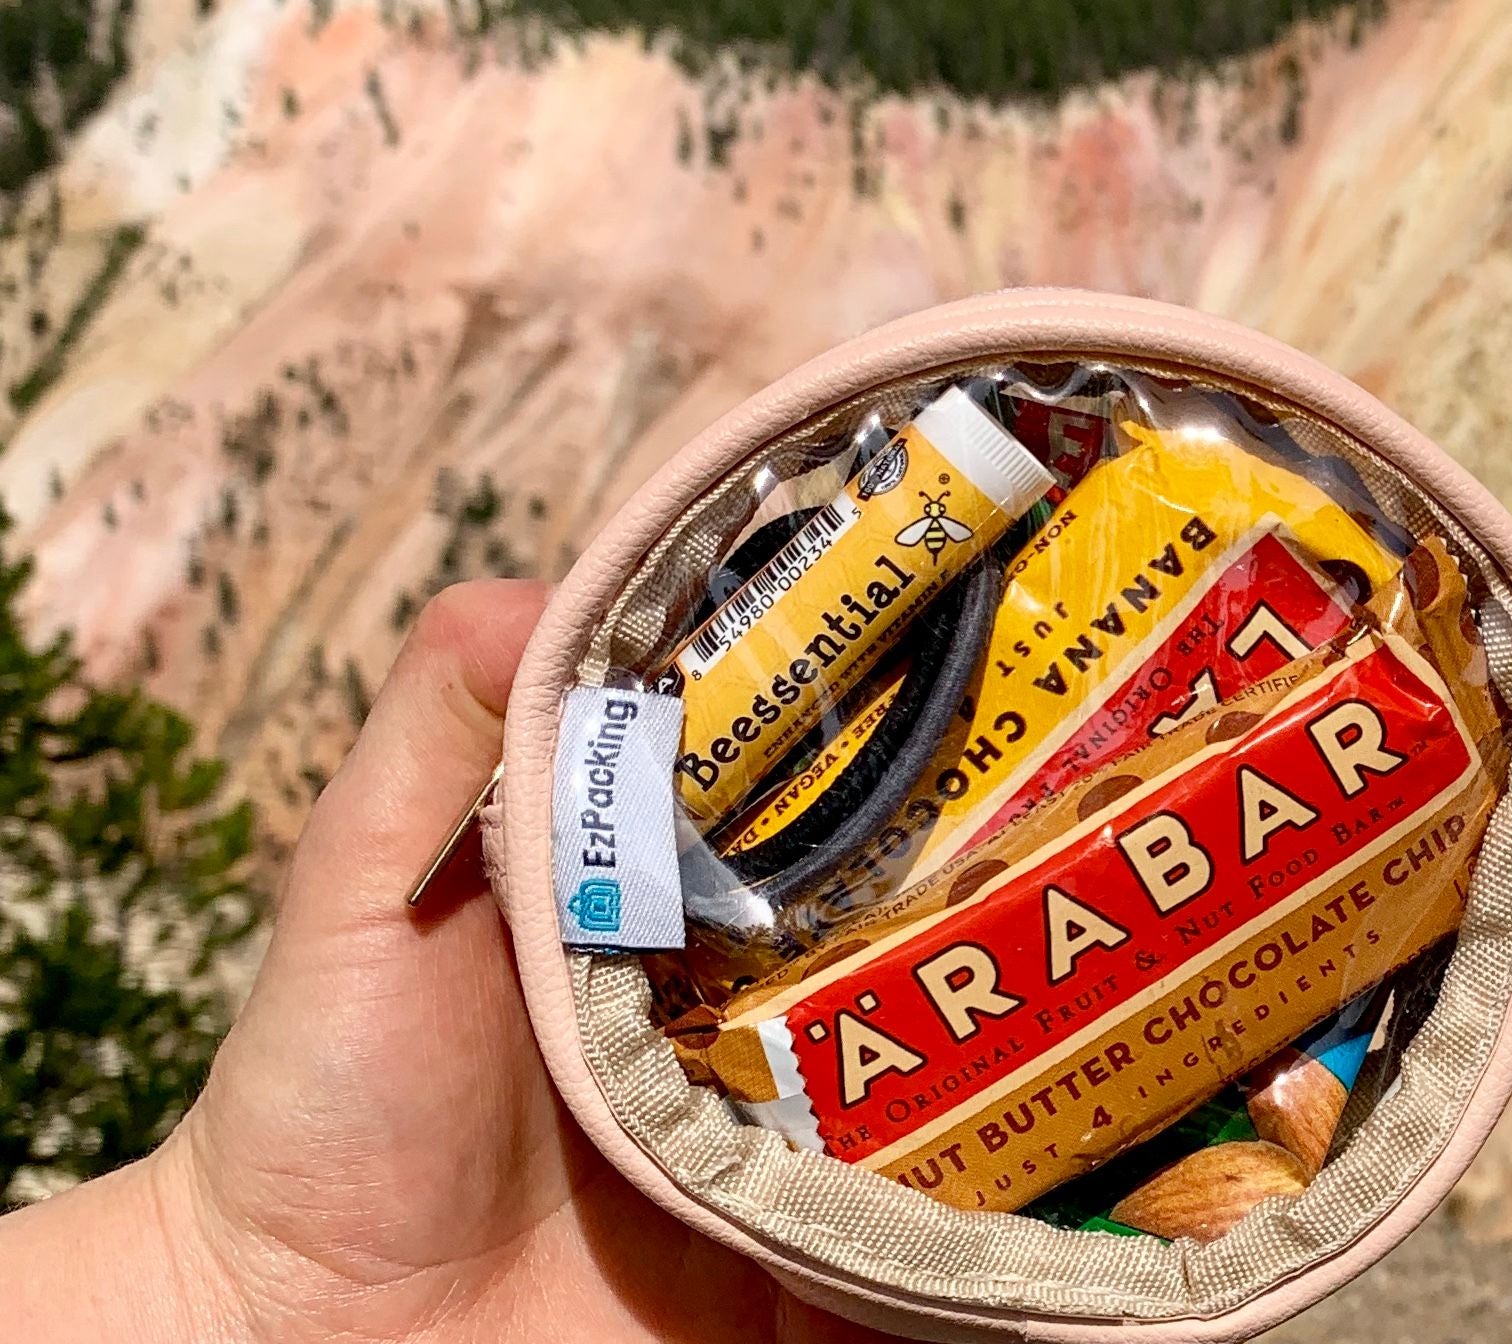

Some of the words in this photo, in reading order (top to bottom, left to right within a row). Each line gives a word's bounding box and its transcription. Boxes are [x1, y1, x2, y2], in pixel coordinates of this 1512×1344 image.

[674, 554, 917, 793] Beessential
[690, 669, 702, 681] 8
[719, 598, 775, 653] 54980
[778, 537, 833, 592] 00234
[851, 506, 863, 520] 5
[876, 581, 940, 650] VITAMIN
[995, 600, 1070, 678] JUST
[1031, 515, 1219, 697] BANANA
[580, 697, 639, 869] EzPacking
[773, 751, 840, 819] VEGAN
[804, 697, 1409, 1112] ÄRABAR
[884, 1036, 1026, 1123] ORIGINAL
[1033, 974, 1119, 1034] FRUIT
[1135, 949, 1161, 973] &
[1174, 901, 1236, 945] NUT
[1247, 848, 1320, 901] FOOD
[976, 1041, 1137, 1155] BUTTER
[1143, 879, 1377, 1046] CHOCOLATE
[1382, 814, 1467, 887] CHIP
[975, 1142, 1059, 1207] JUST
[1091, 1104, 1114, 1131] 4
[1137, 928, 1381, 1100] INGREDIENTS
